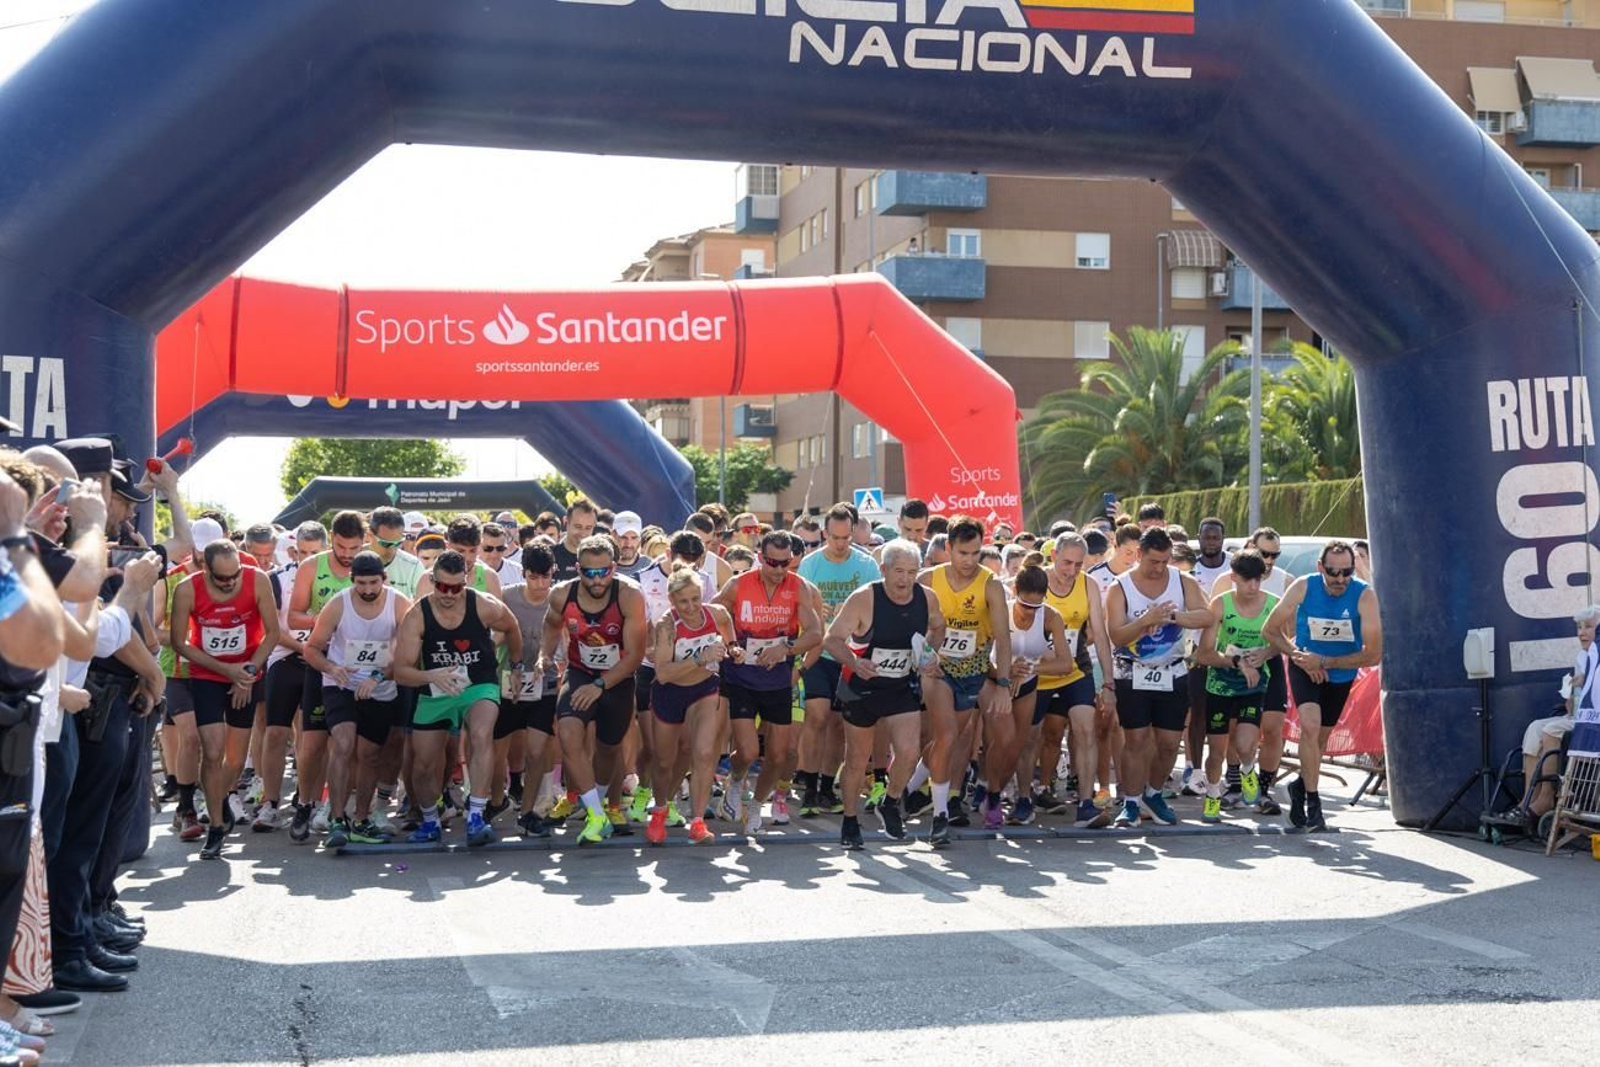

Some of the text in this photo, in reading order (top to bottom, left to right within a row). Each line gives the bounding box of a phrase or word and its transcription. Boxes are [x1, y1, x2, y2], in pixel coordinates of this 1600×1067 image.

[789, 20, 1193, 79] NACIONAL
[355, 309, 727, 353] Sports Santander
[475, 359, 600, 375] sportssantander.es
[1487, 376, 1596, 452] RUTA
[950, 466, 1001, 486] Sports
[1321, 626, 1341, 637] 73
[209, 635, 240, 649] 515
[436, 641, 448, 652] I
[942, 637, 968, 651] 176
[356, 650, 378, 662] 84
[431, 650, 481, 664] KRABI
[589, 653, 608, 664] 72
[879, 658, 908, 670] 444
[1144, 671, 1163, 683] 40
